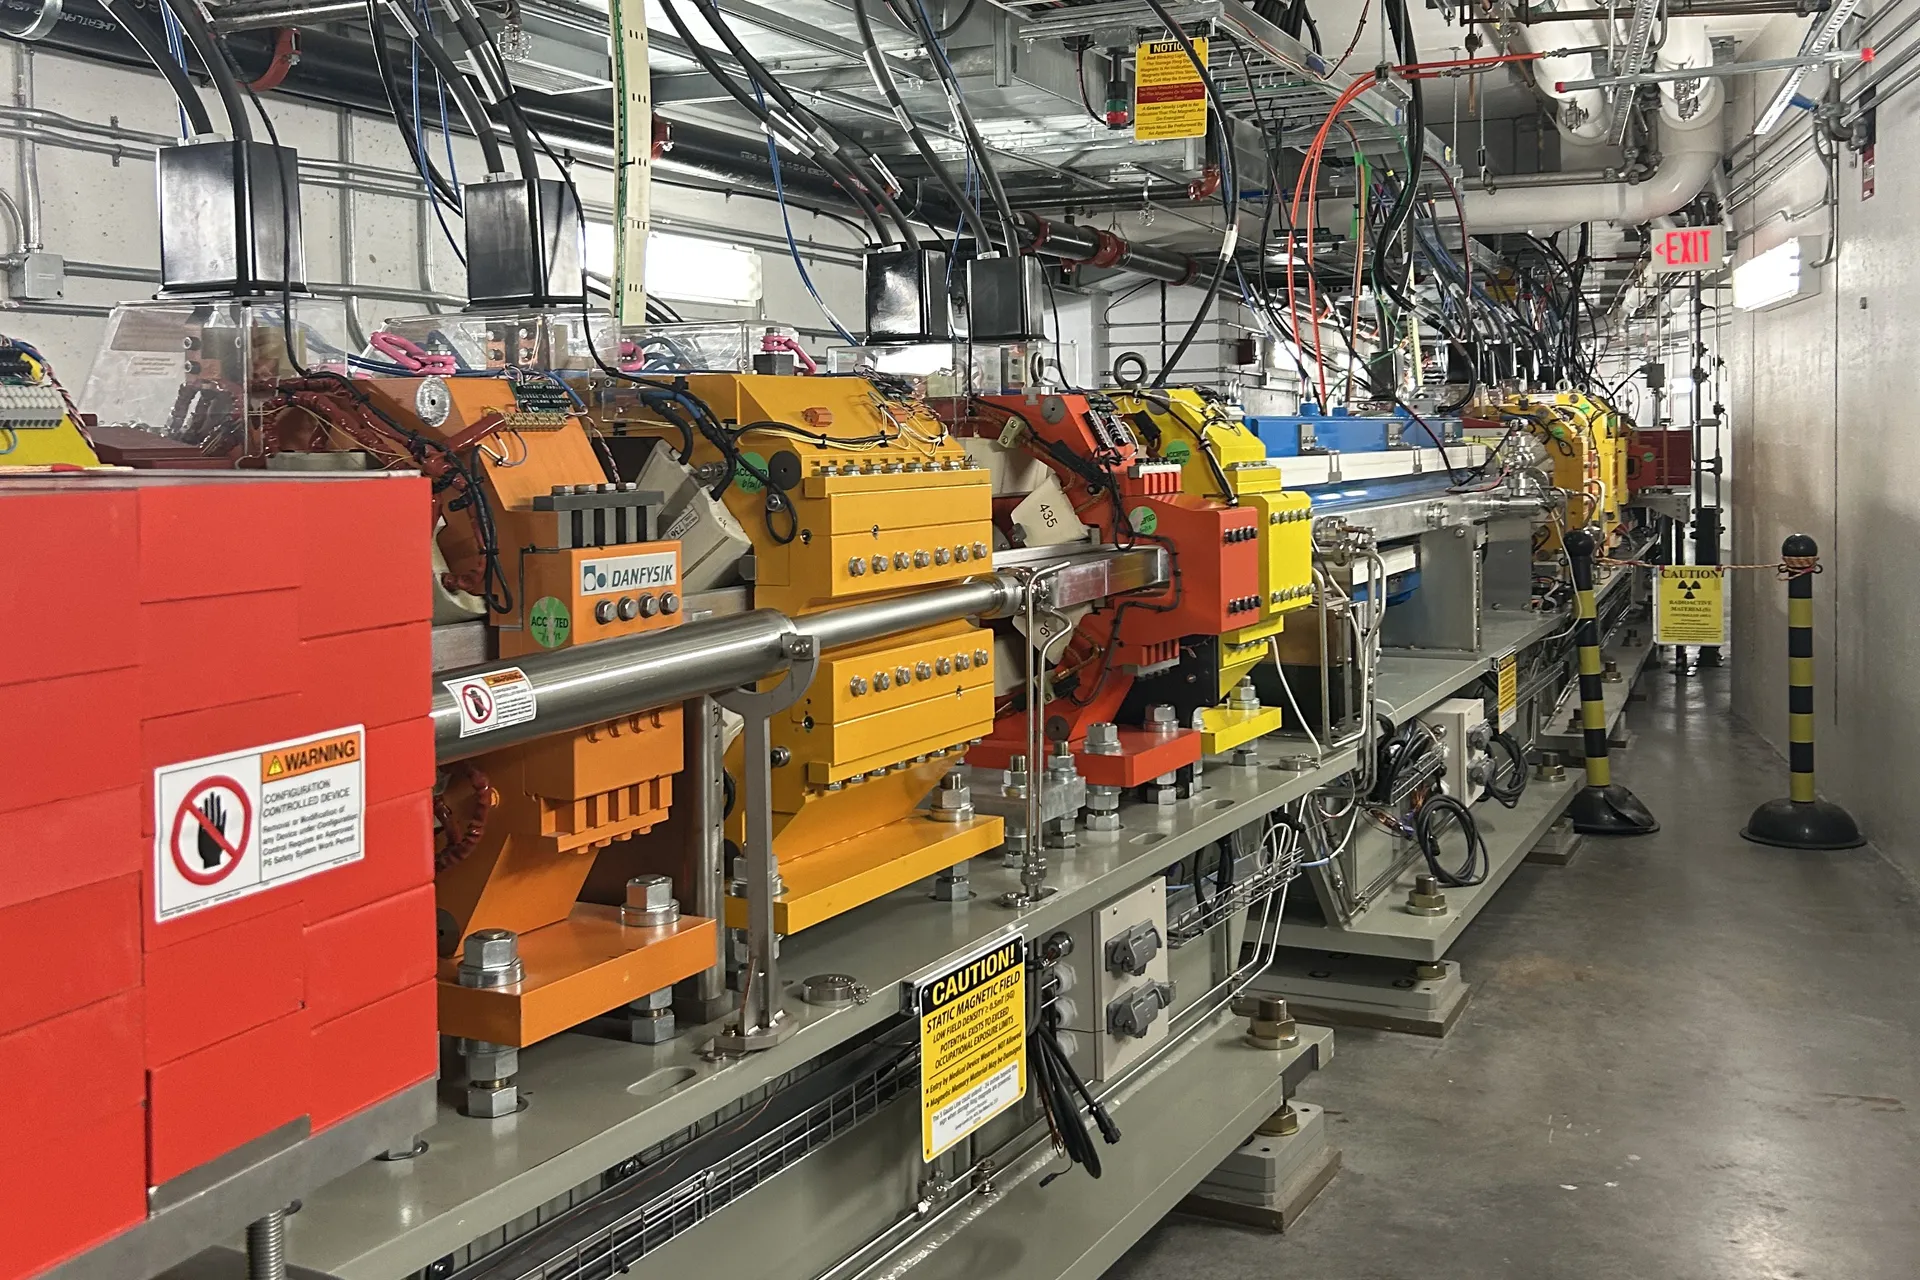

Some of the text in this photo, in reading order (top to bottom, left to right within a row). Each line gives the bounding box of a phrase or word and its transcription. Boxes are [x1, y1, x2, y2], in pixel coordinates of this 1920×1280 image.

[1153, 43, 1184, 53] NOTIC
[1666, 230, 1711, 264] EXIT
[1040, 503, 1058, 529] 435
[611, 564, 674, 588] DANFYSIK
[284, 740, 355, 771] WARNING
[263, 787, 350, 818] CONTROLLED DEVICE
[264, 780, 330, 804] CONFIGURATION
[262, 821, 290, 833] Removal
[300, 809, 337, 823] Modification
[338, 805, 345, 813] of
[262, 814, 358, 845] any Device under Configuration
[262, 844, 286, 856] Control
[288, 836, 314, 848] Requires
[325, 824, 354, 838] Approved
[274, 854, 293, 864] Safety
[295, 846, 317, 859] System
[318, 841, 333, 850] Work
[932, 943, 1015, 1006] CAUTION!
[926, 970, 1020, 1034] STATIC MAGNETIC FIELD
[933, 1029, 946, 1043] LOW
[946, 1020, 962, 1036] FIELD
[962, 1008, 984, 1026] DENSITY
[989, 995, 1004, 1010] 0.5mT
[940, 1006, 1009, 1054] POTENTIAL EXISTS TO EXCEED
[935, 1015, 1014, 1069] OCCUPATIONAL EXPOSURE LIMITS
[930, 1030, 1021, 1094] Entry by Medical Device Wearers NOT Allowed
[930, 1090, 950, 1107] Magnetic
[950, 1078, 969, 1094] Memory
[970, 1065, 987, 1082] Material
[988, 1060, 997, 1070] May
[1002, 1043, 1022, 1061] Damaged
